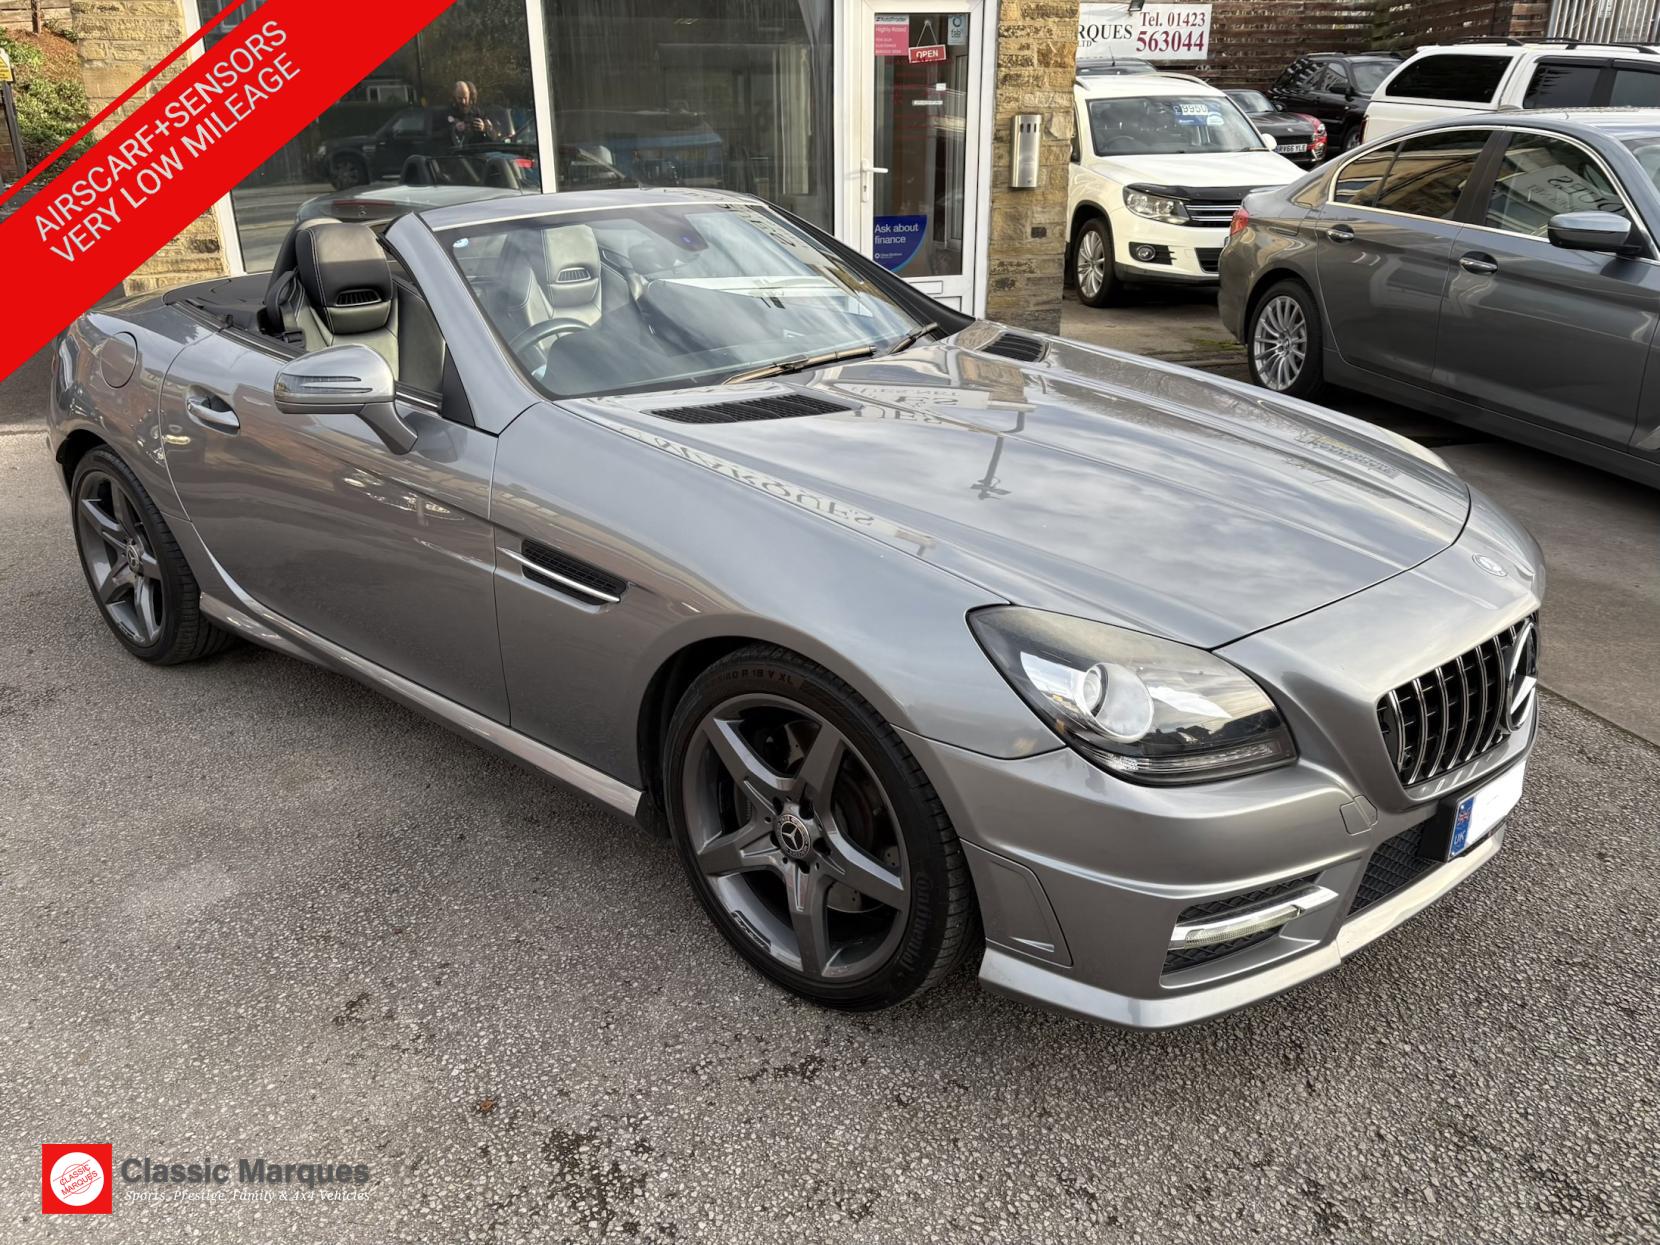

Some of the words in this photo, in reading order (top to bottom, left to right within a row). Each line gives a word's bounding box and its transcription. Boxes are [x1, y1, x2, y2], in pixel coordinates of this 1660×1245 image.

[1140, 12, 1163, 27] Tel.
[1167, 12, 1206, 27] 01423
[1136, 30, 1204, 52] 563044
[916, 49, 939, 59] OPEN
[874, 223, 891, 233] Ask
[893, 223, 919, 233] about
[874, 235, 906, 244] finance
